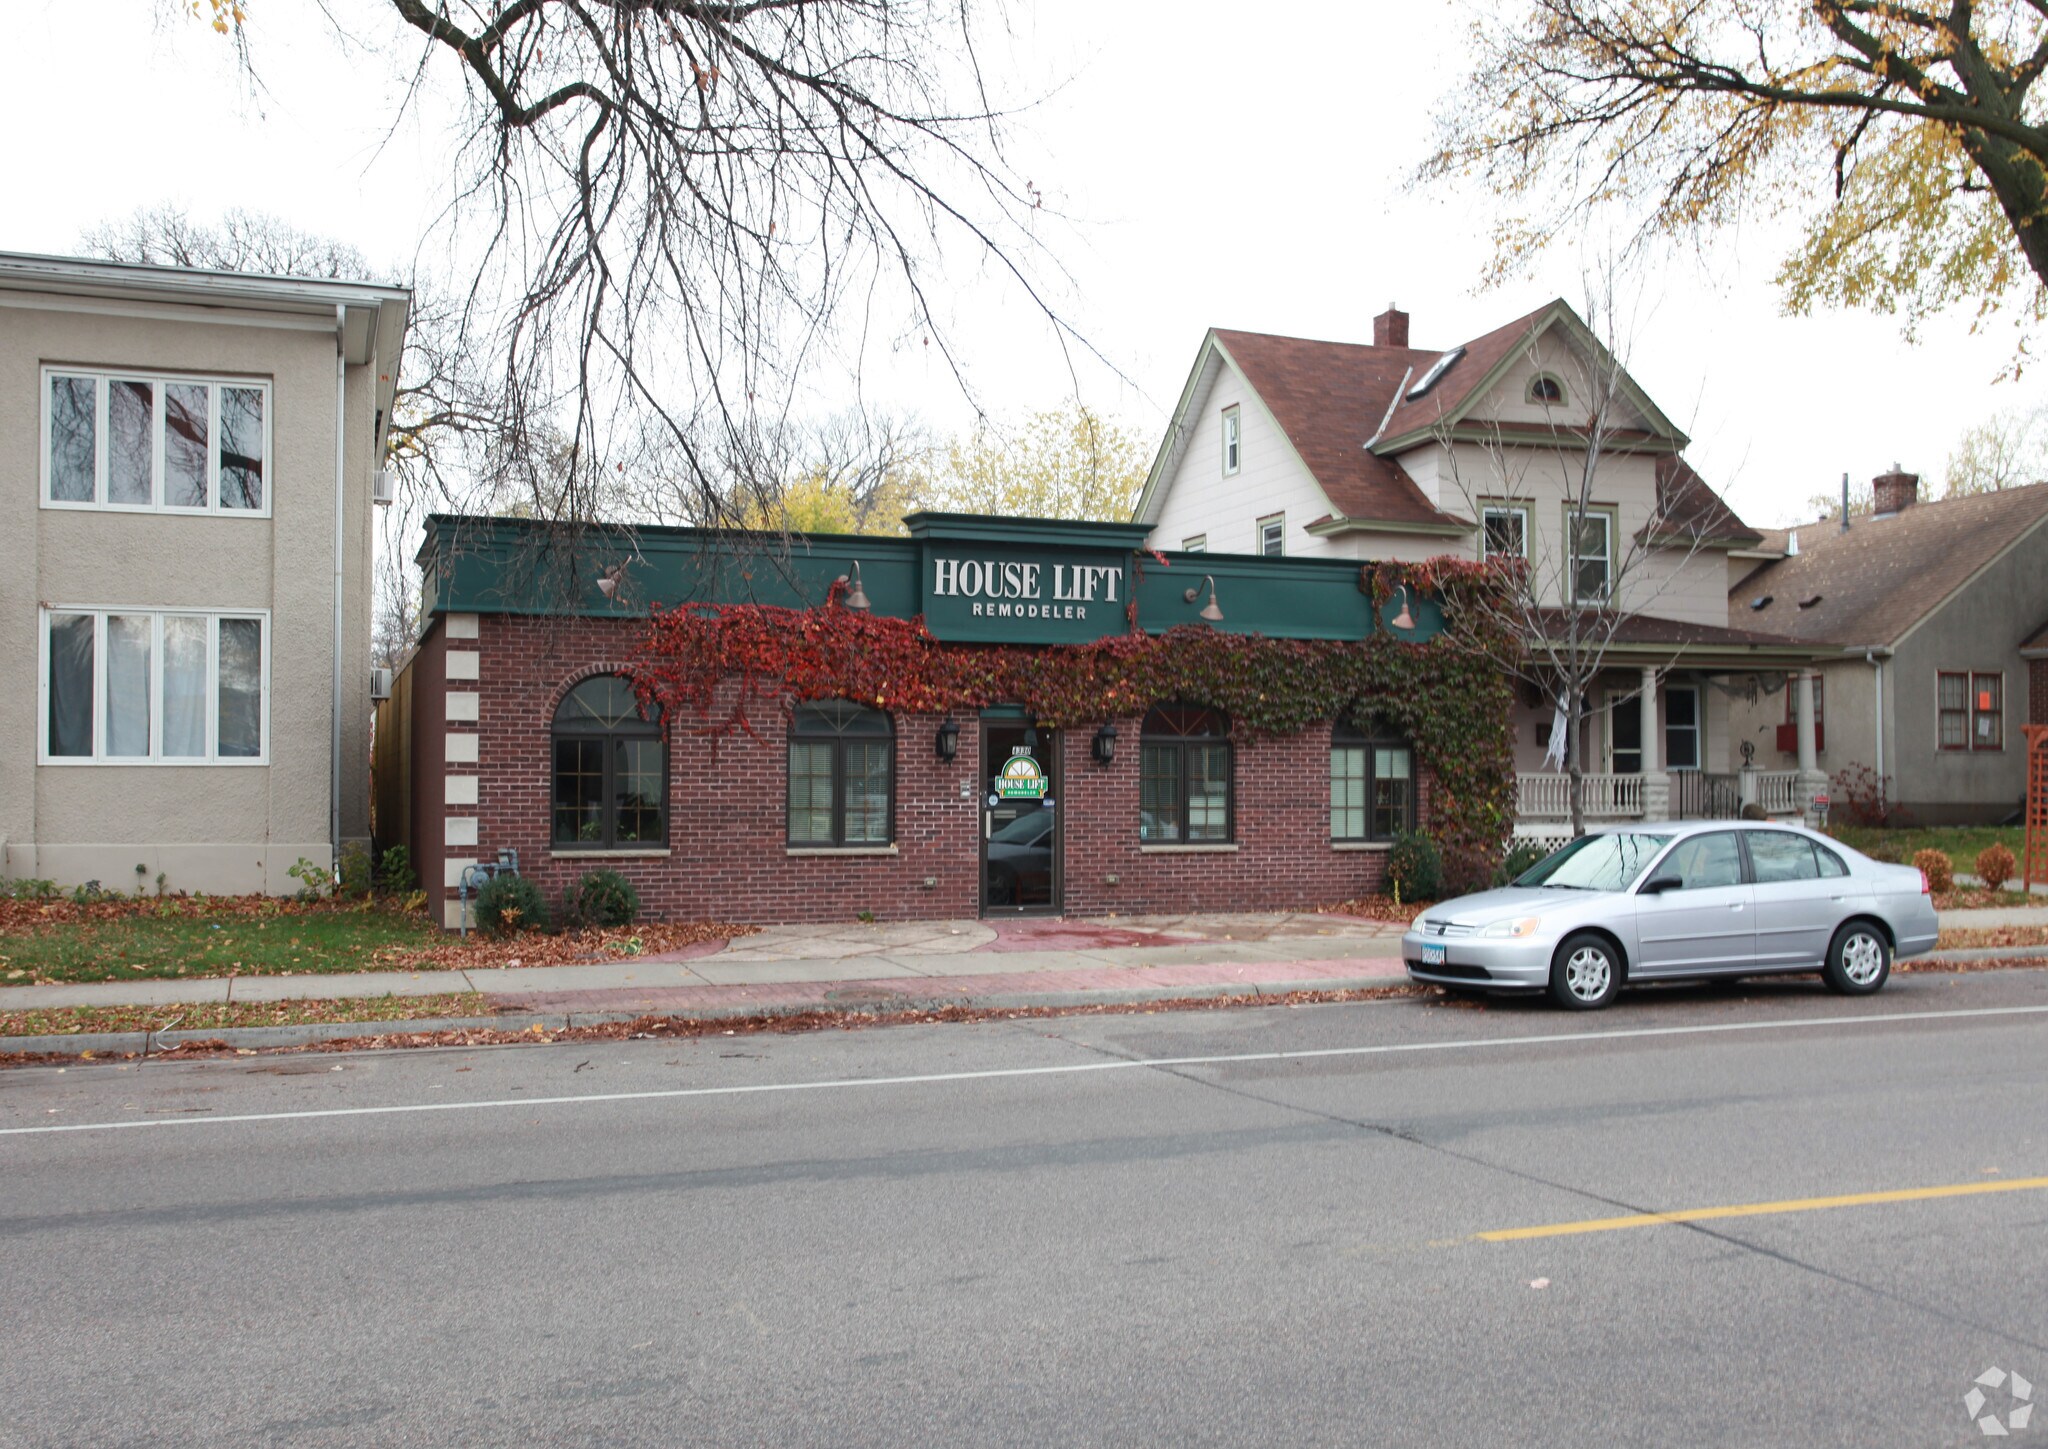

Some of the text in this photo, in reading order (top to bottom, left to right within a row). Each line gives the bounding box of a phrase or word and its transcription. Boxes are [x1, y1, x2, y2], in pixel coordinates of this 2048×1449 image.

[933, 558, 1122, 602] HOUSE LIFT
[972, 602, 1086, 620] REMODELER
[998, 779, 1044, 789] HOUSE LIFT
